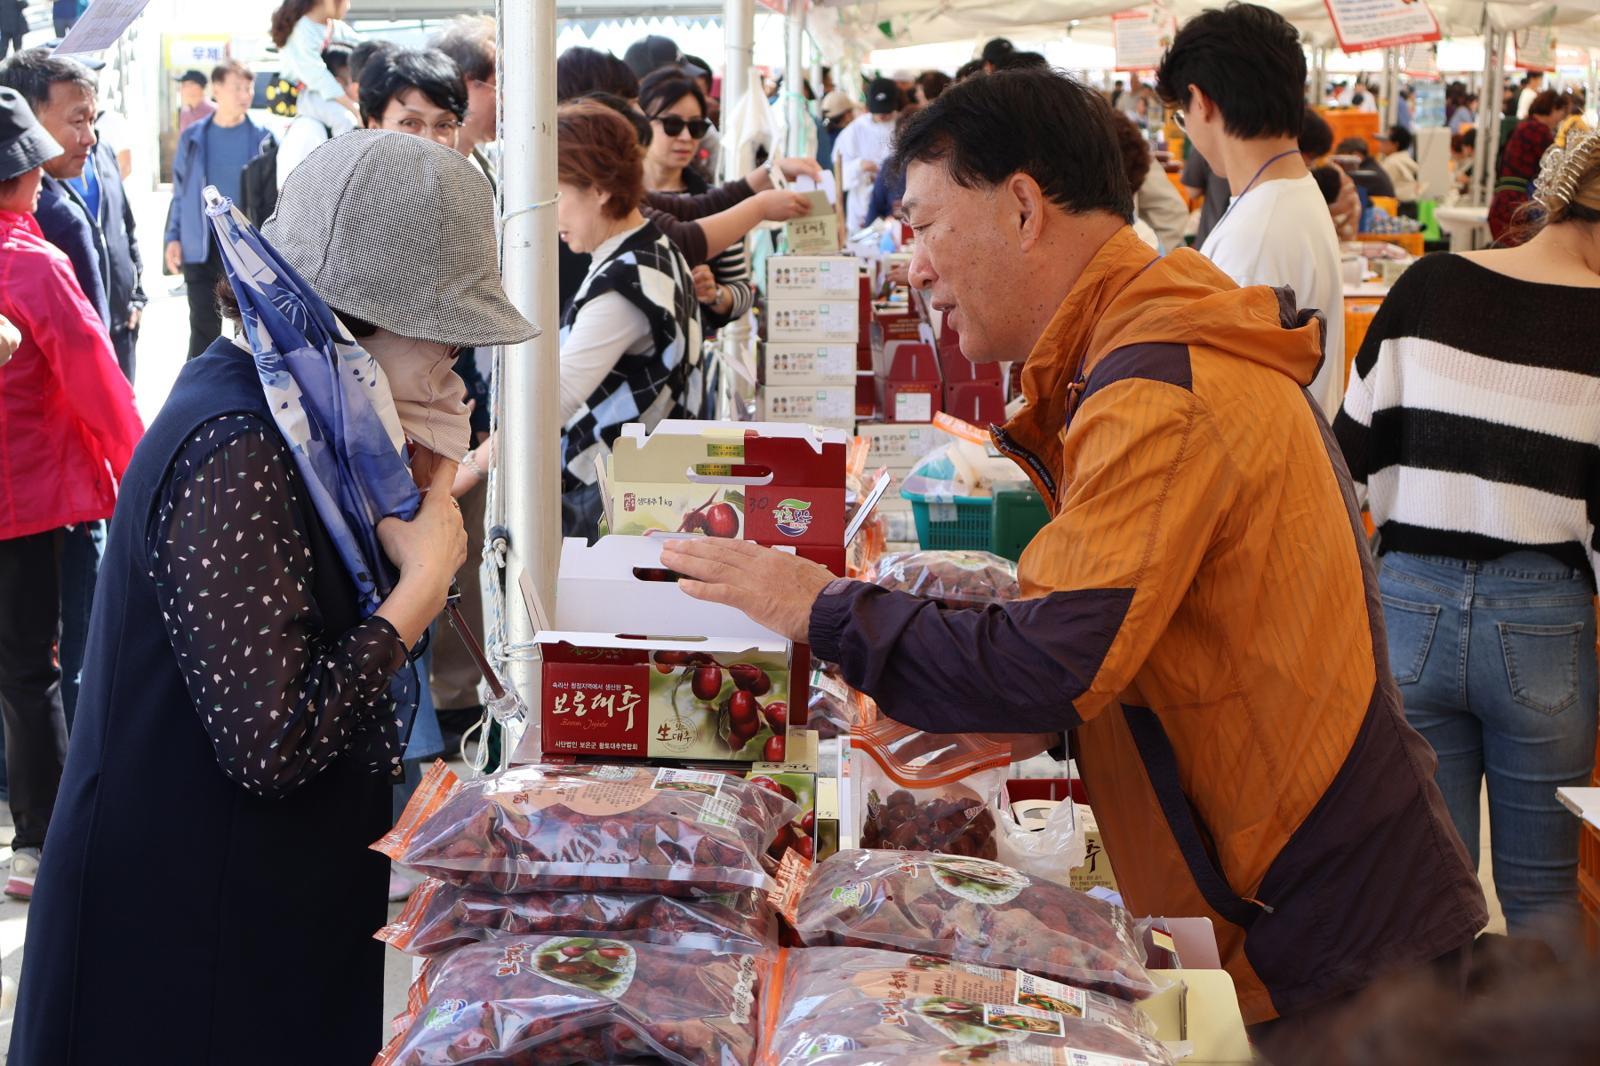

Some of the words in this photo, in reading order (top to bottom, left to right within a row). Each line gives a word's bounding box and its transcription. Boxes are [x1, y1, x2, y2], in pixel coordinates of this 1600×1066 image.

[637, 496, 657, 506] 생대추
[552, 681, 569, 689] 속리산
[552, 684, 642, 732] 보은대추
[555, 740, 578, 749] 사단법인
[579, 741, 597, 750] 보은군
[598, 742, 639, 752] 황토대추연합회
